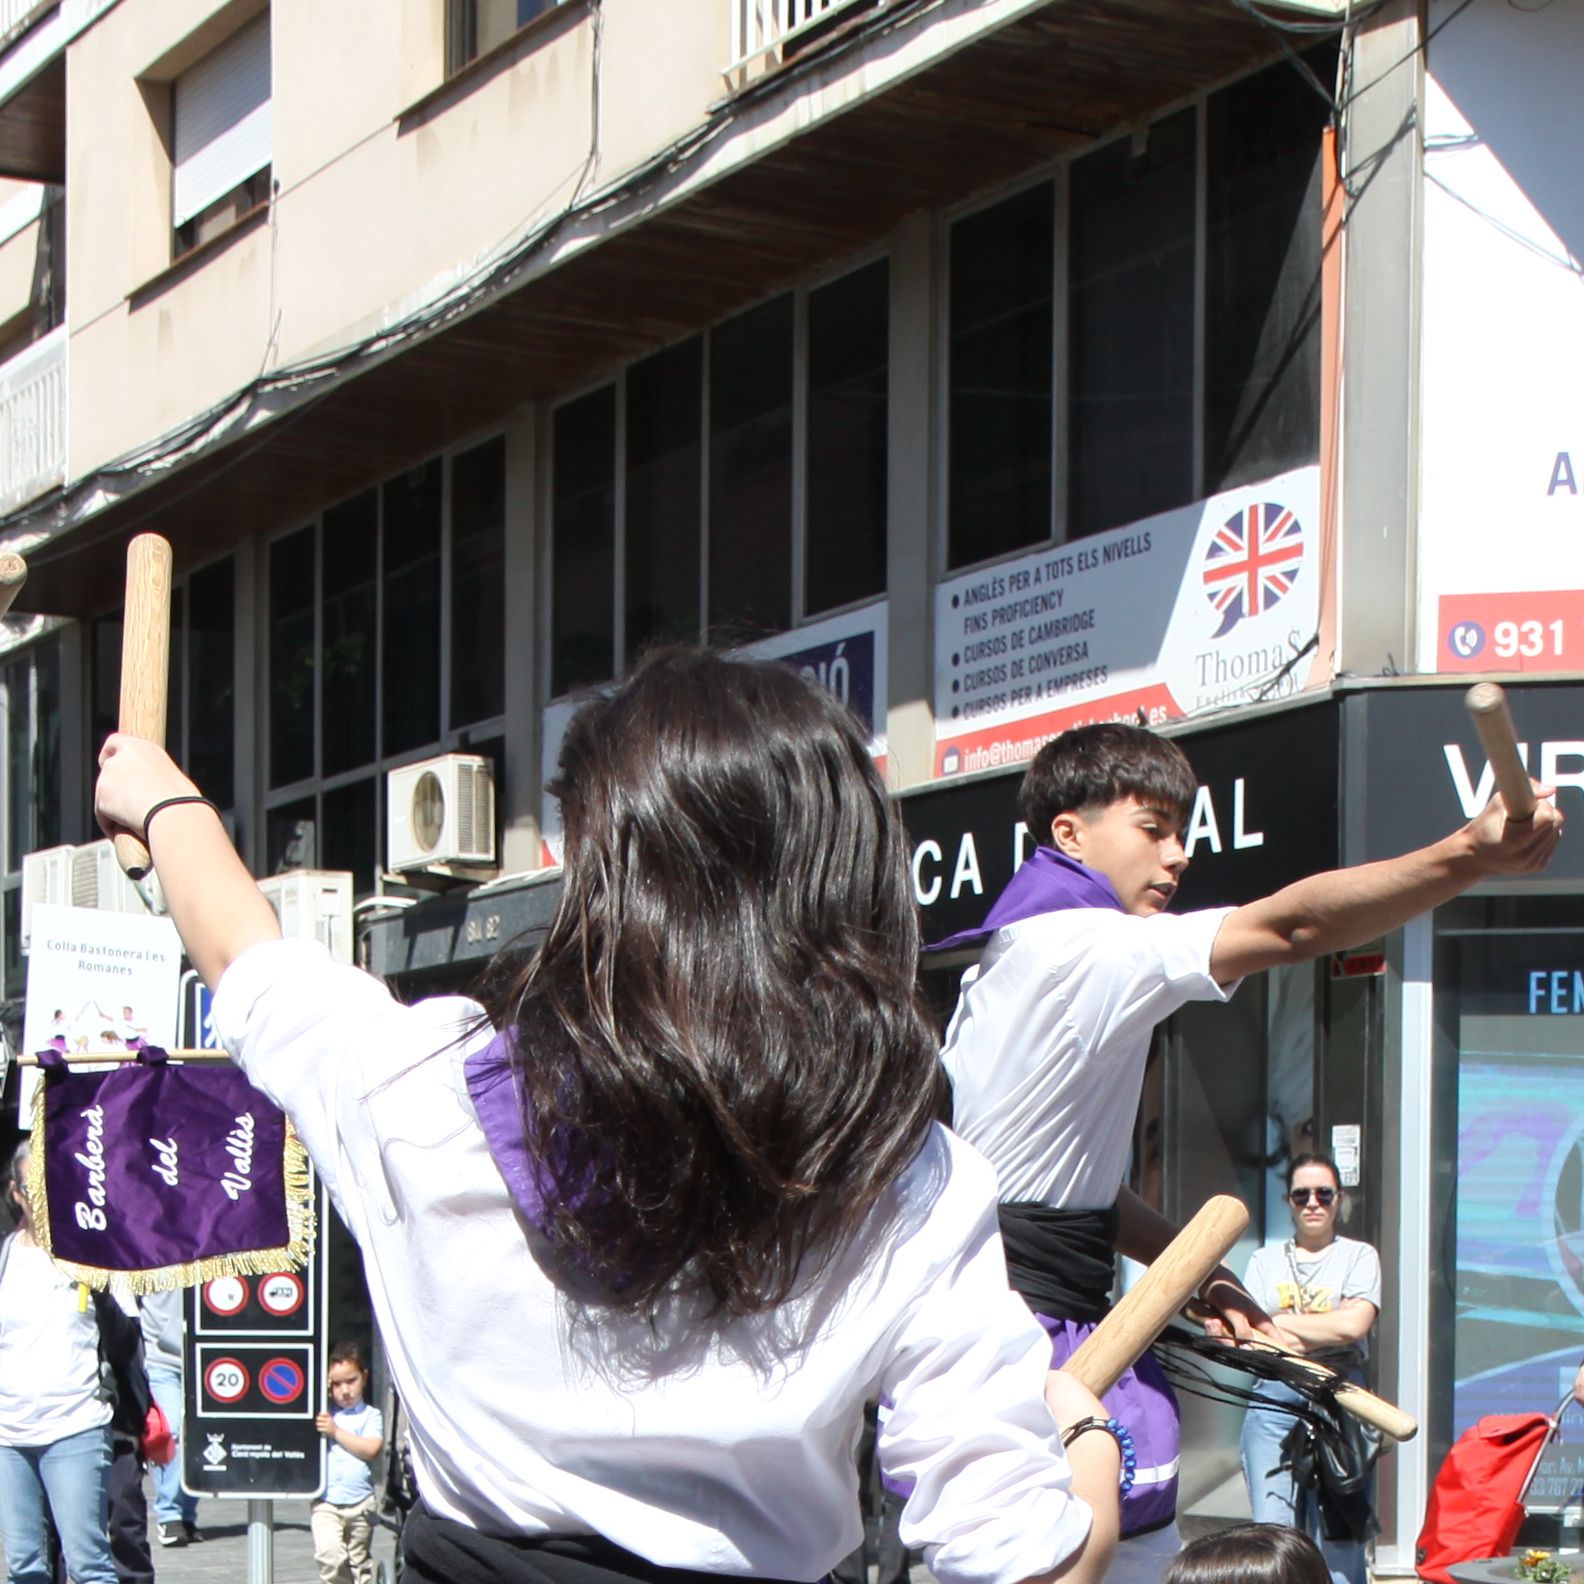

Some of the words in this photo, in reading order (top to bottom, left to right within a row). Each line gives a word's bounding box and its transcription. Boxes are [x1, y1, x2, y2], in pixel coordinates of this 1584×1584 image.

[964, 577, 1006, 608] ANGLÈS
[1009, 571, 1031, 594] PER
[1034, 569, 1043, 585] A
[1046, 556, 1074, 581] TOTS
[1077, 549, 1099, 572] ELS
[1103, 532, 1152, 564] NIVELLS
[964, 611, 988, 636] FINS
[991, 588, 1065, 628] PROFICIENCY
[964, 635, 1008, 664] CURSOS
[1010, 630, 1025, 651] DE
[1028, 608, 1095, 645] CAMBRIDGE
[1493, 619, 1564, 658] 931
[964, 664, 1008, 692] CURSOS
[1010, 659, 1026, 680] DE
[1028, 641, 1089, 675] CONVERSA
[1010, 688, 1032, 707] PER
[1035, 685, 1043, 702] A
[1046, 664, 1109, 695] EMPRESES
[47, 939, 78, 953] Colla
[80, 943, 144, 961] Bastonera
[78, 960, 134, 976] Romanes
[150, 1137, 180, 1188] del
[219, 1112, 257, 1201] Vallès
[216, 1373, 240, 1387] 20
